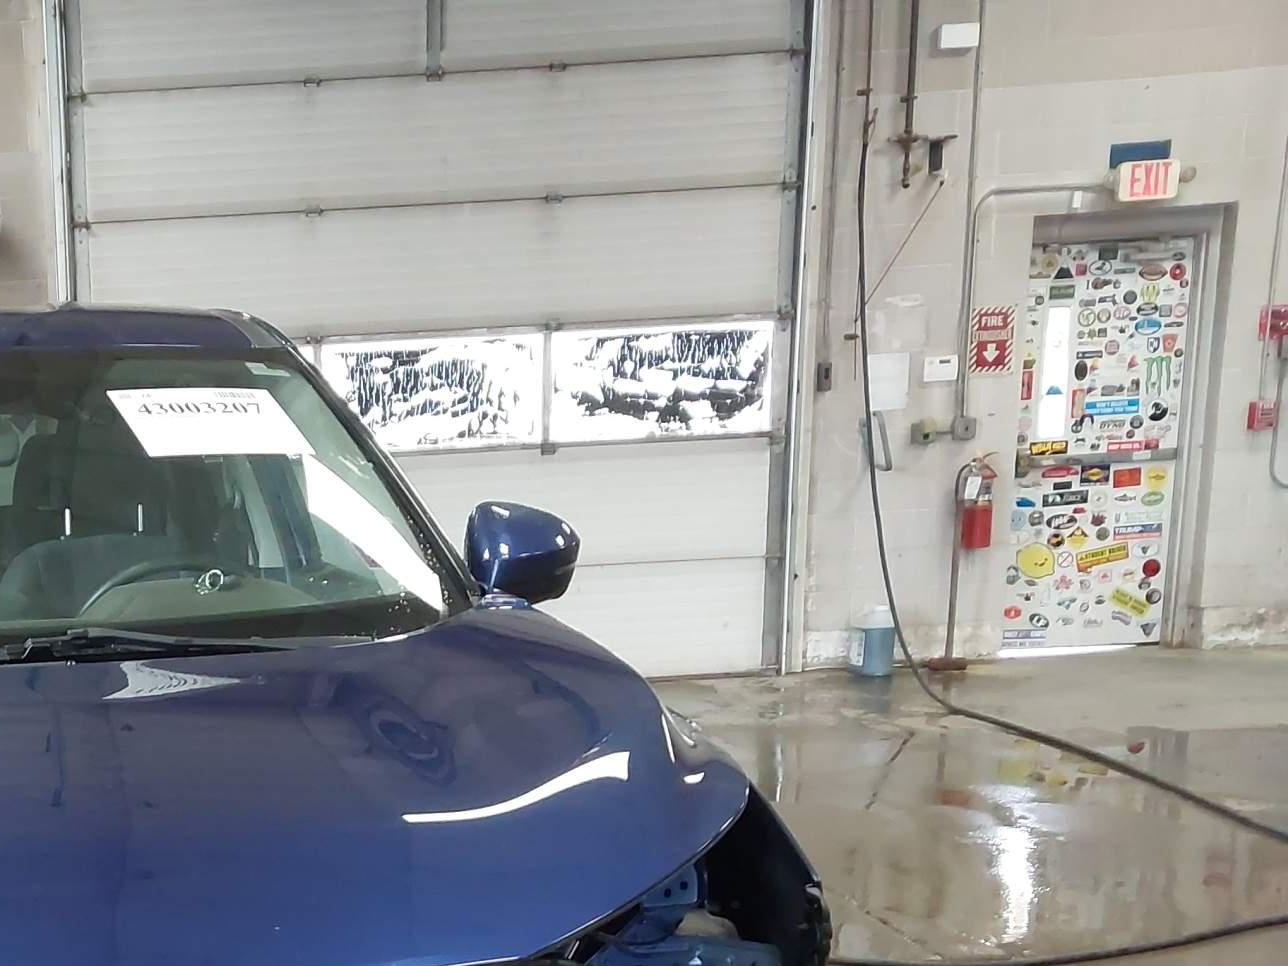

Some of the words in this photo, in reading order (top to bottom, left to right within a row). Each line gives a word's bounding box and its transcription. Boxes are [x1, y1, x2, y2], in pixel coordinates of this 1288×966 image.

[1129, 162, 1172, 197] EXIT
[981, 315, 1004, 327] FIRE
[138, 402, 261, 415] 43003207
